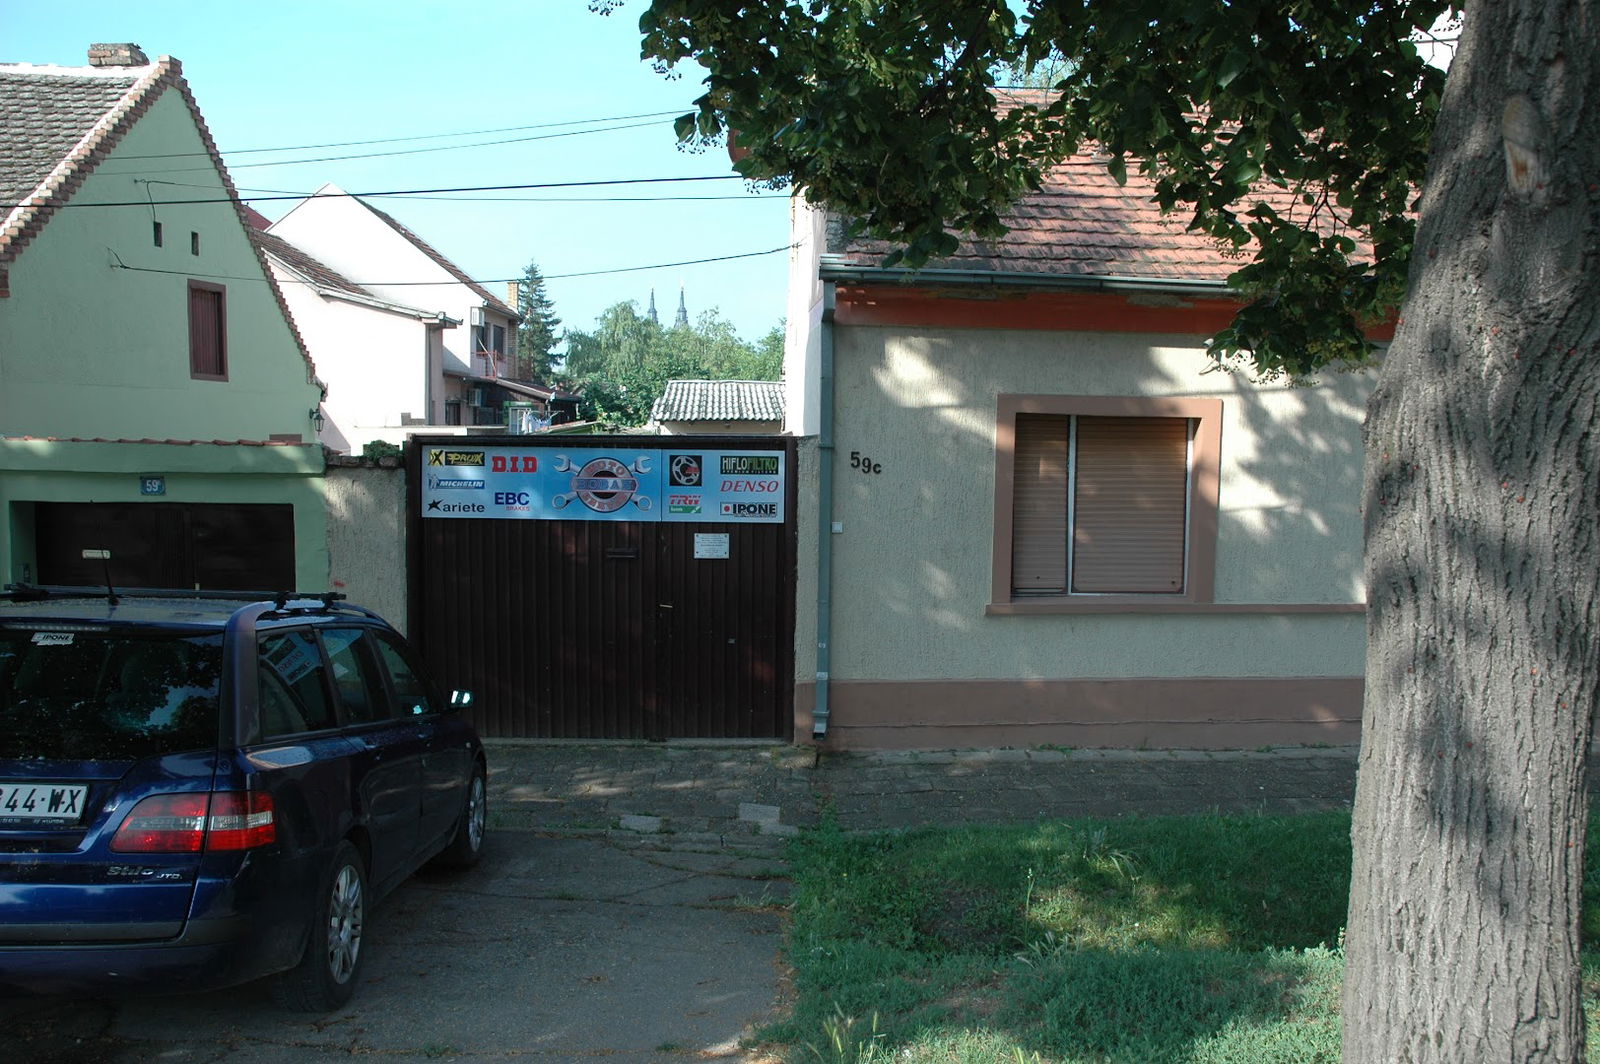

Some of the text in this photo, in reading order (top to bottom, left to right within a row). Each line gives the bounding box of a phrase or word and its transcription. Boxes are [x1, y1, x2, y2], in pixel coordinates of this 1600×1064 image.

[492, 456, 538, 473] D.I.D
[850, 451, 882, 474] 59c
[720, 480, 779, 492] DENSO
[494, 492, 530, 505] EBC
[669, 494, 701, 504] TRW
[442, 502, 485, 512] ariete
[733, 504, 776, 514] IPONE
